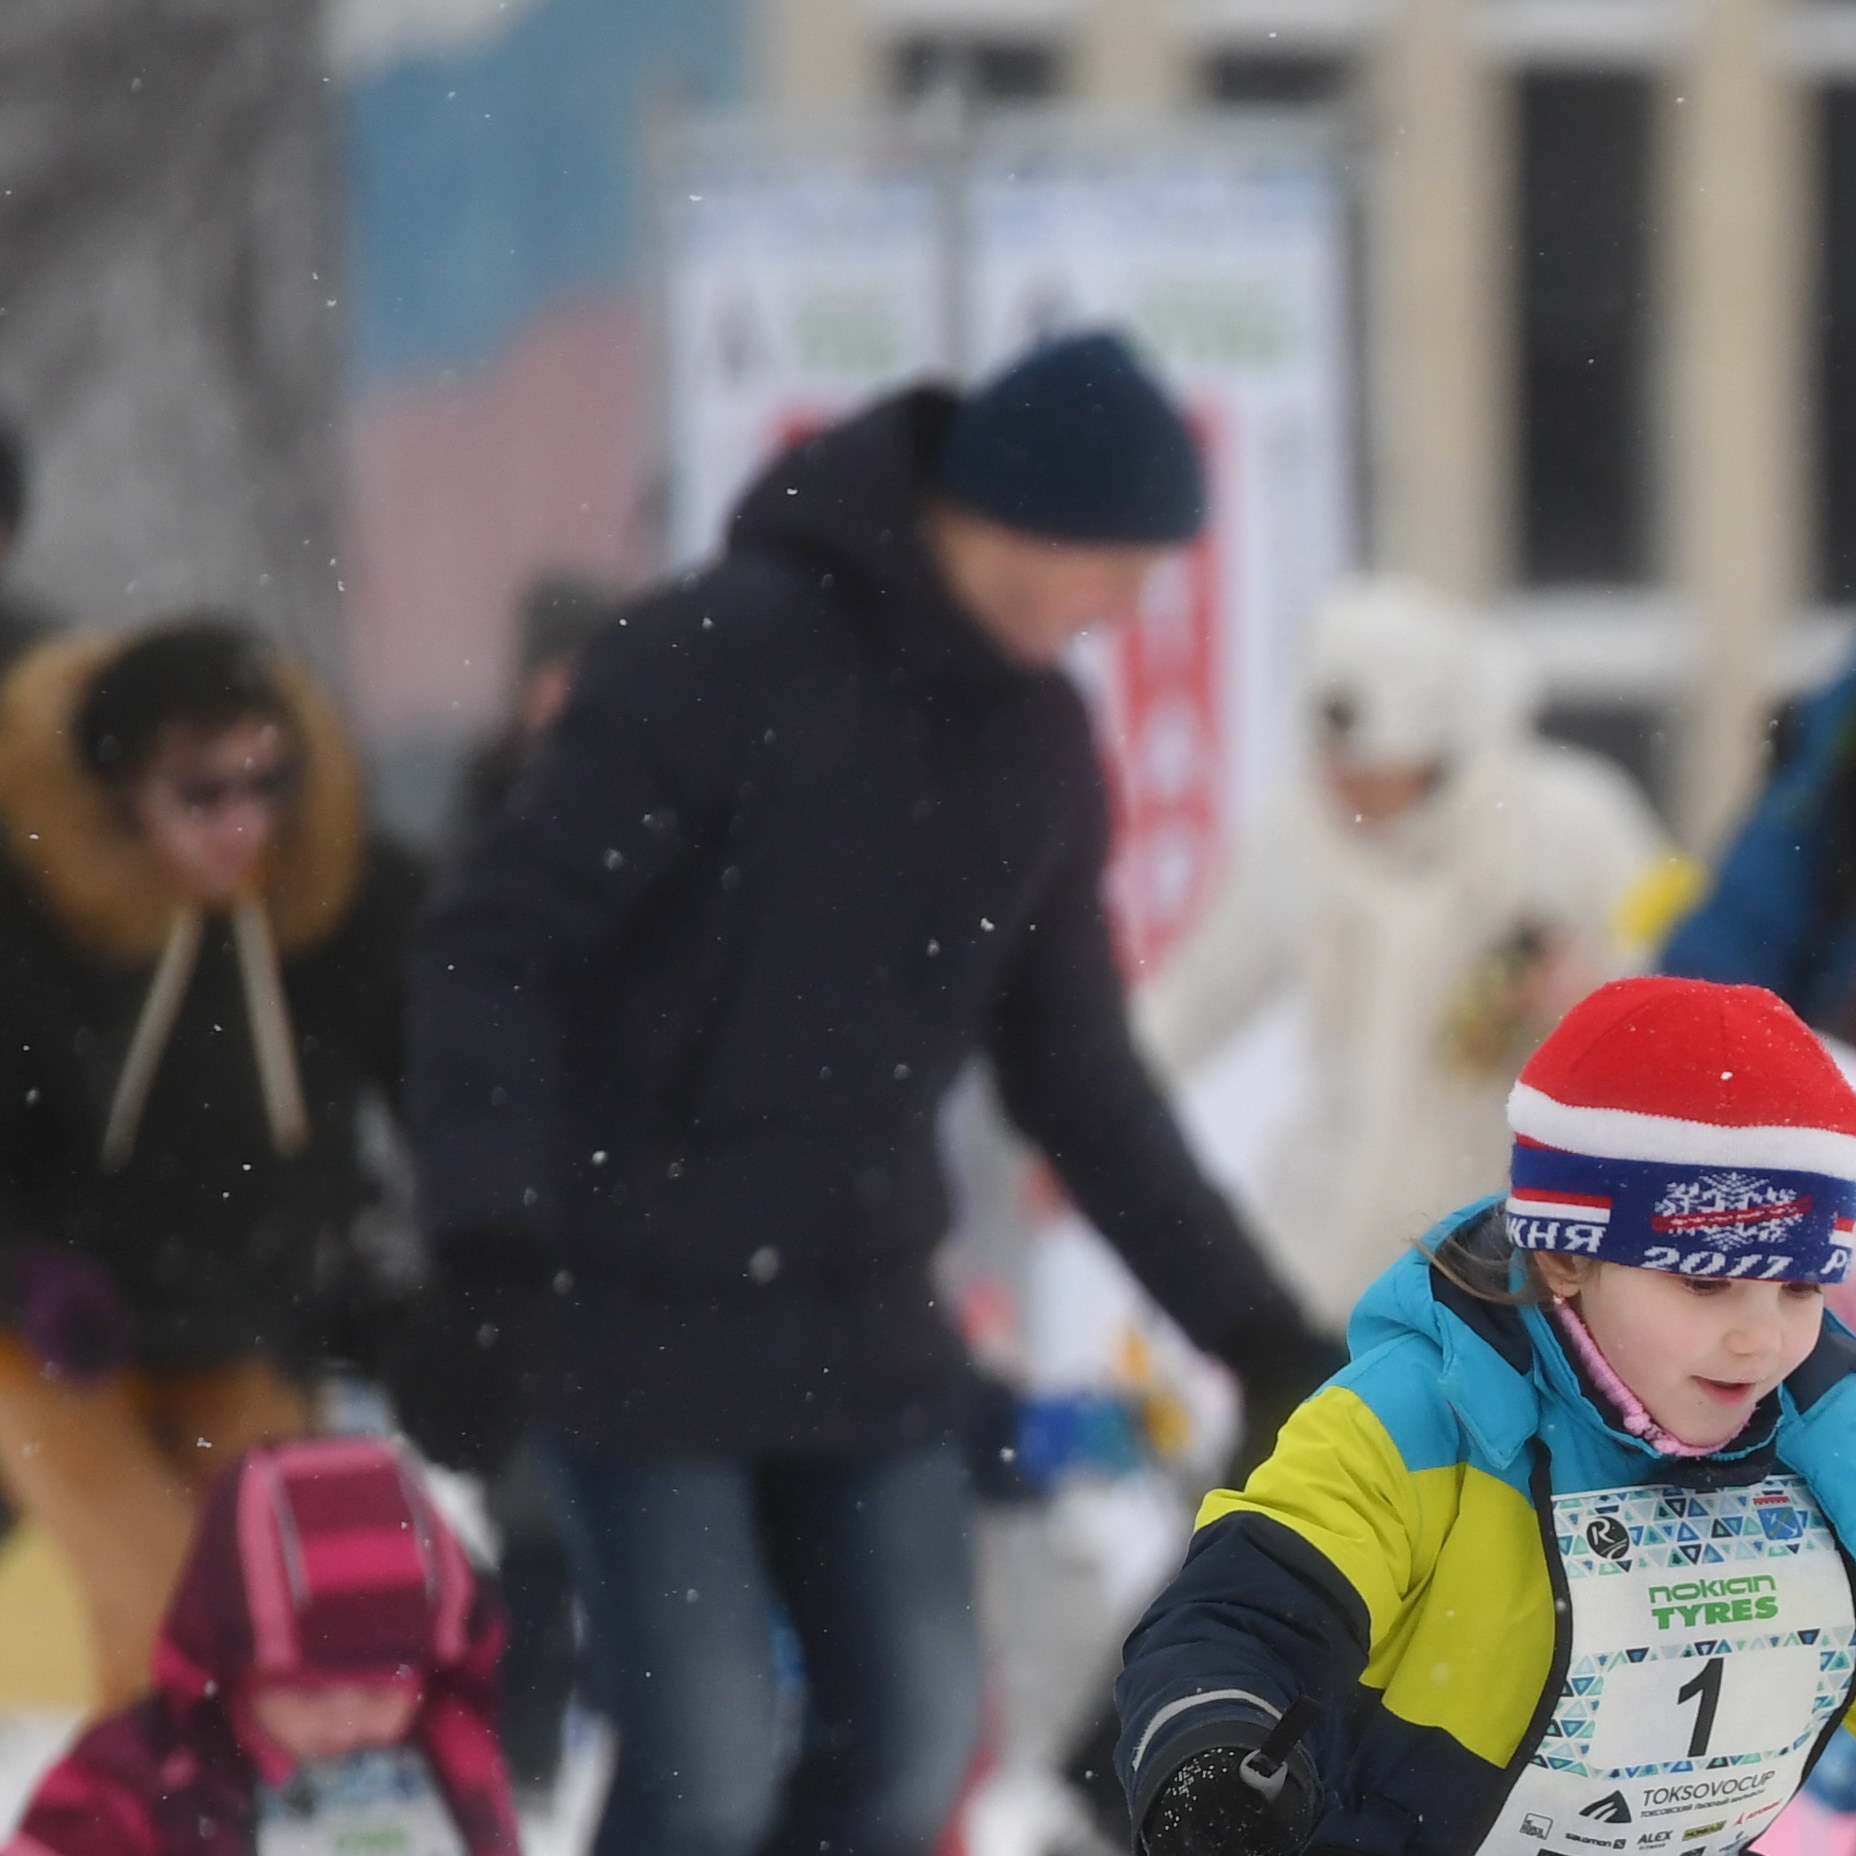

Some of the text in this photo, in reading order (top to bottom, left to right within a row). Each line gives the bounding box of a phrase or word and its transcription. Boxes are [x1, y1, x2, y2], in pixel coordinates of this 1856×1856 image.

[1641, 1246, 1794, 1280] 2017
[1648, 1574, 1777, 1604] nokian
[1651, 1596, 1780, 1630] TYRES
[1677, 1657, 1725, 1758] 1
[1643, 1770, 1776, 1807] TOKSOVOCUP
[1637, 1829, 1674, 1845] ALEX
